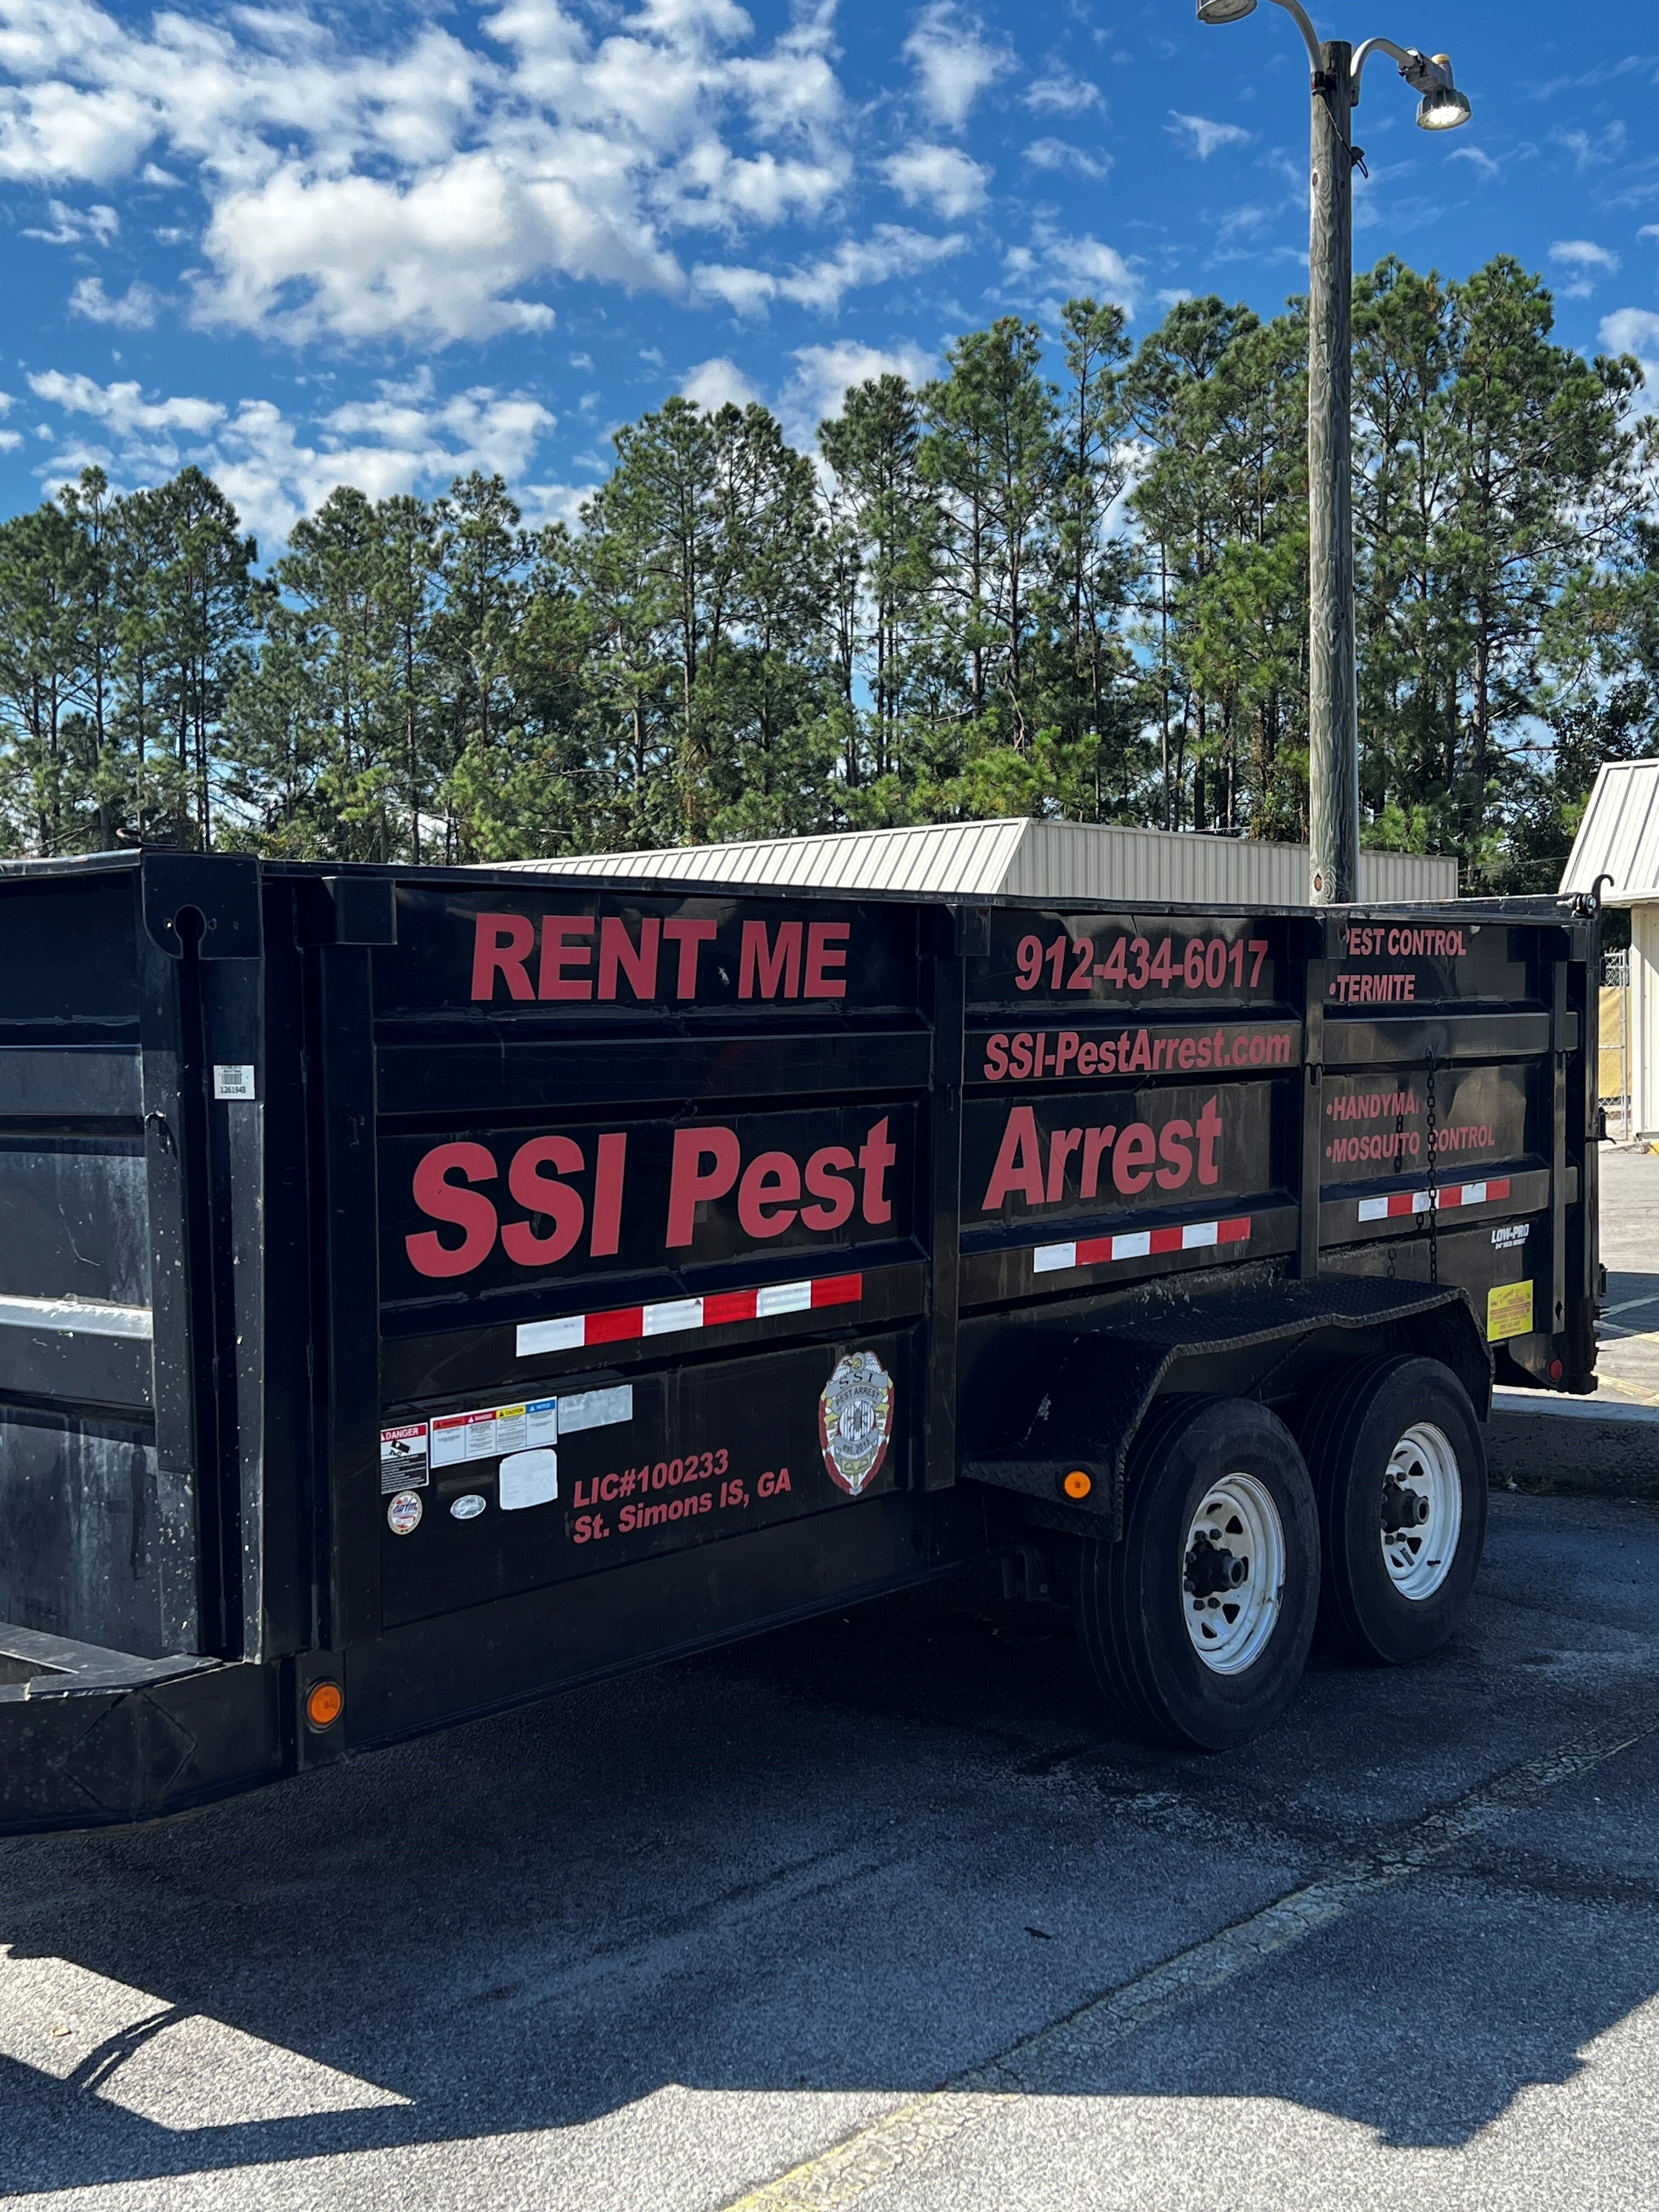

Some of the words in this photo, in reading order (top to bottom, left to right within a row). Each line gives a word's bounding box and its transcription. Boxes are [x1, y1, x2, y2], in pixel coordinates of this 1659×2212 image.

[471, 913, 717, 1001] RENT
[738, 921, 850, 999] ME
[1387, 928, 1466, 956] CONTROL
[1014, 935, 1268, 990] 912-434-6017
[1336, 974, 1415, 1002] TERMITE
[984, 1029, 1290, 1081] SSI-PestArrest.com
[1332, 1090, 1420, 1121] HANDYMA
[1332, 1131, 1420, 1164] MOSQUITO
[1427, 1124, 1496, 1153] CONTROL
[405, 1132, 628, 1278] SSI
[665, 1115, 896, 1248] Pest
[981, 1094, 1222, 1211] Arrest
[1491, 1223, 1530, 1244] LOW-PRO
[836, 1389, 852, 1406] PEST
[854, 1386, 880, 1400] ARREST
[839, 1371, 873, 1390] SSI
[385, 1427, 419, 1440] DANGER
[573, 1448, 729, 1509] LIC#100233
[573, 1512, 610, 1544] St.
[618, 1492, 713, 1533] Simons
[757, 1468, 792, 1498] GA
